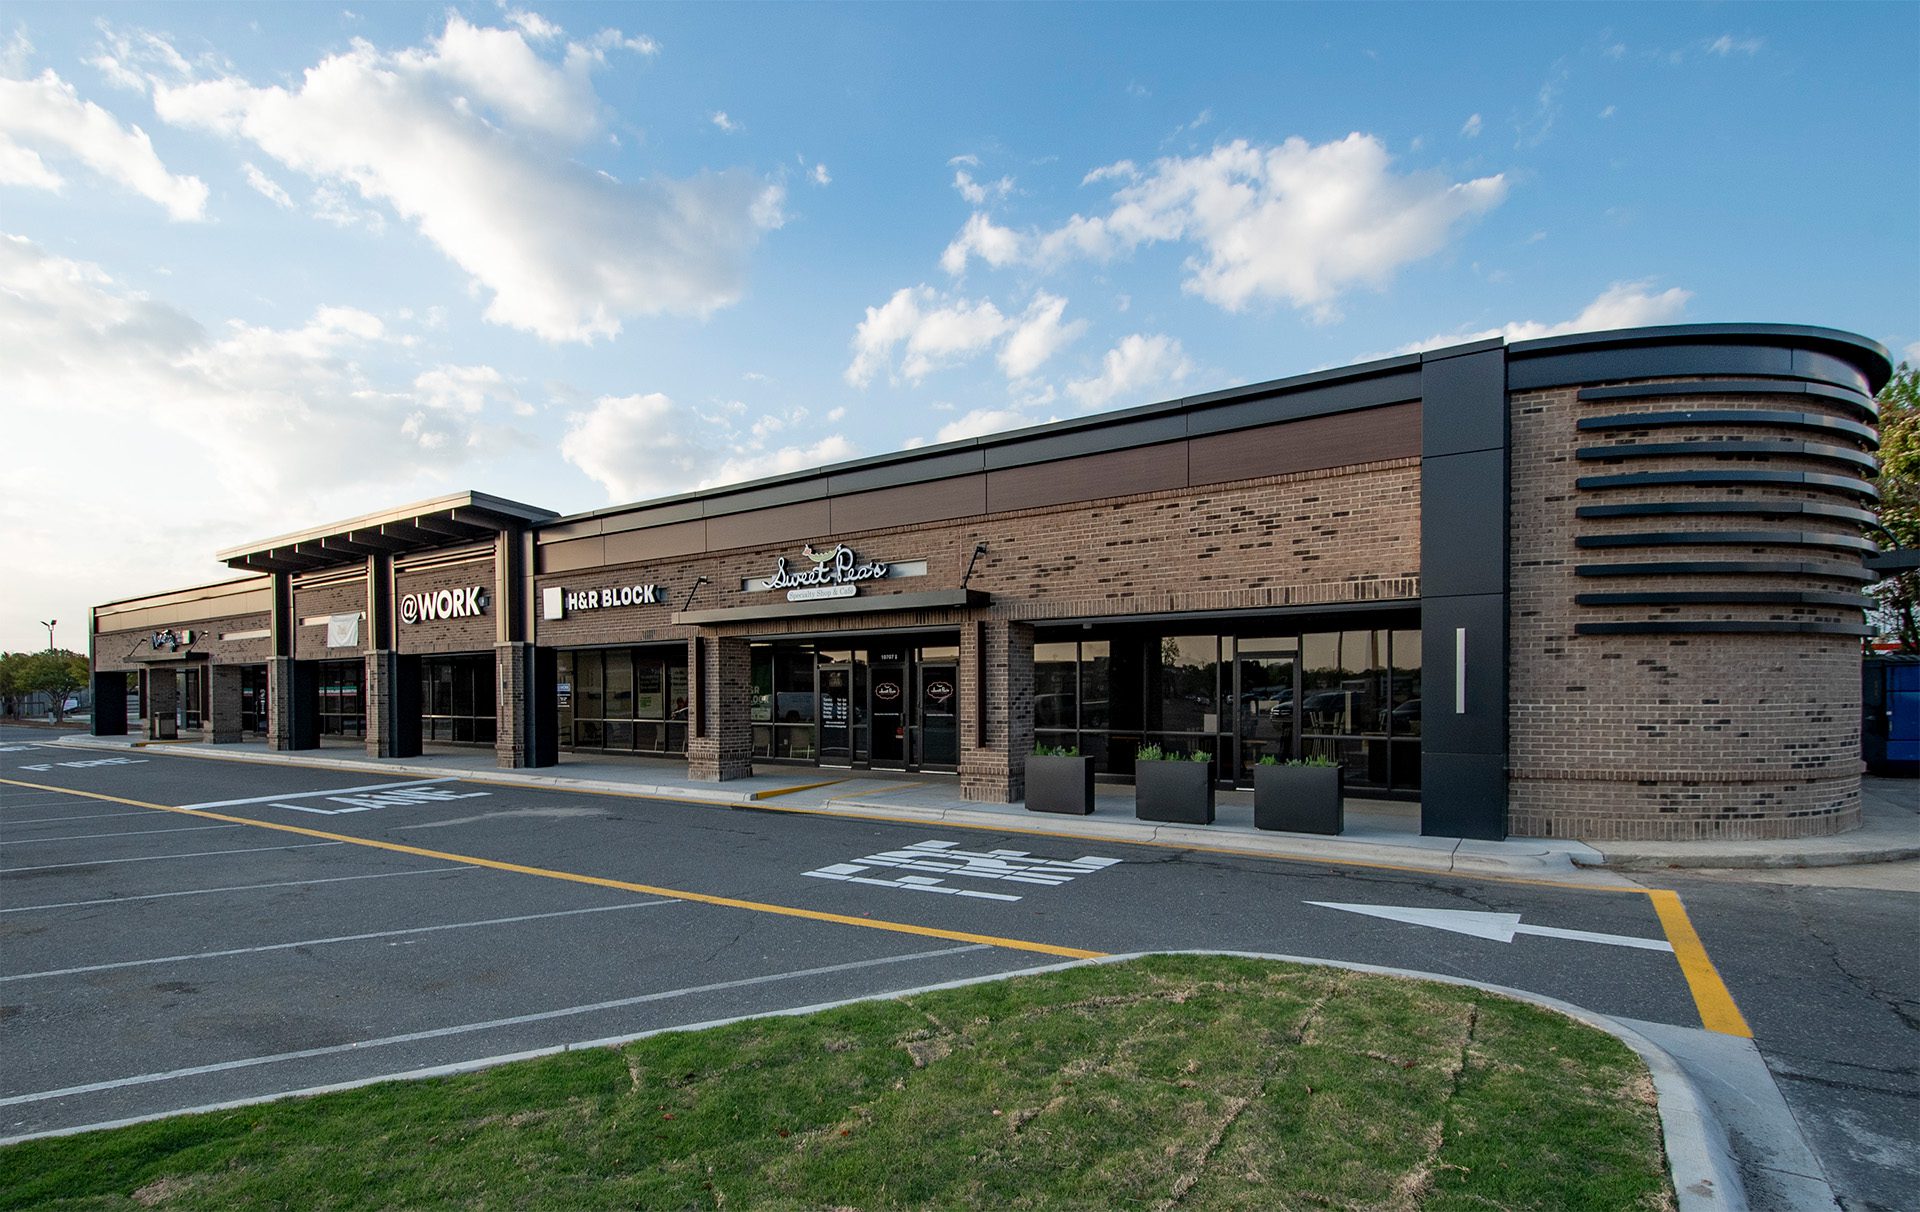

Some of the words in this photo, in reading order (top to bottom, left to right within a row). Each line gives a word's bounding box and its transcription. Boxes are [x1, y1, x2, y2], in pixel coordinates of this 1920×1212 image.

[761, 557, 831, 589] Sweet
[836, 547, 887, 583] Pea's
[401, 586, 480, 624] @WORK
[568, 590, 599, 611] H&R
[602, 584, 656, 608] BLOCK
[789, 590, 815, 600] Specialty
[816, 589, 832, 597] Shop
[832, 588, 838, 596] &
[18, 757, 150, 771] FIRE
[267, 787, 493, 815] LANE
[800, 839, 1123, 902] FIRE
